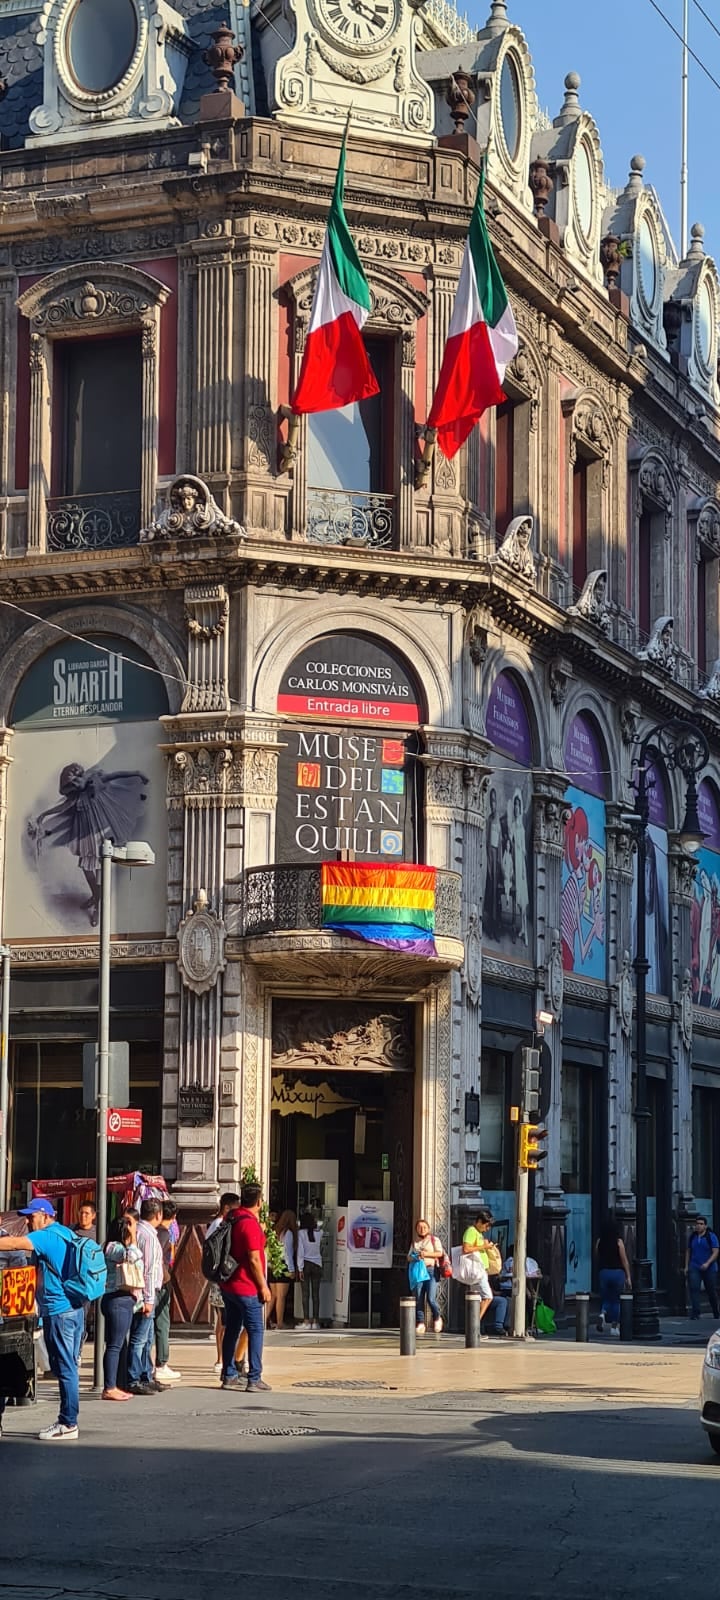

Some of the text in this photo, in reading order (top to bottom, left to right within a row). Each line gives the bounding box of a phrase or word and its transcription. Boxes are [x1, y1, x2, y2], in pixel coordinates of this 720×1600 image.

[53, 652, 123, 705] SMARTH
[306, 661, 392, 679] COLECCIONES
[288, 677, 409, 697] CARLOS MONSIVÁIS
[80, 701, 123, 715] RESPLANDOR
[307, 698, 390, 716] Entrada libre
[325, 765, 379, 793] DEL
[295, 793, 401, 825] ESTAN
[271, 1084, 325, 1119] Mixup
